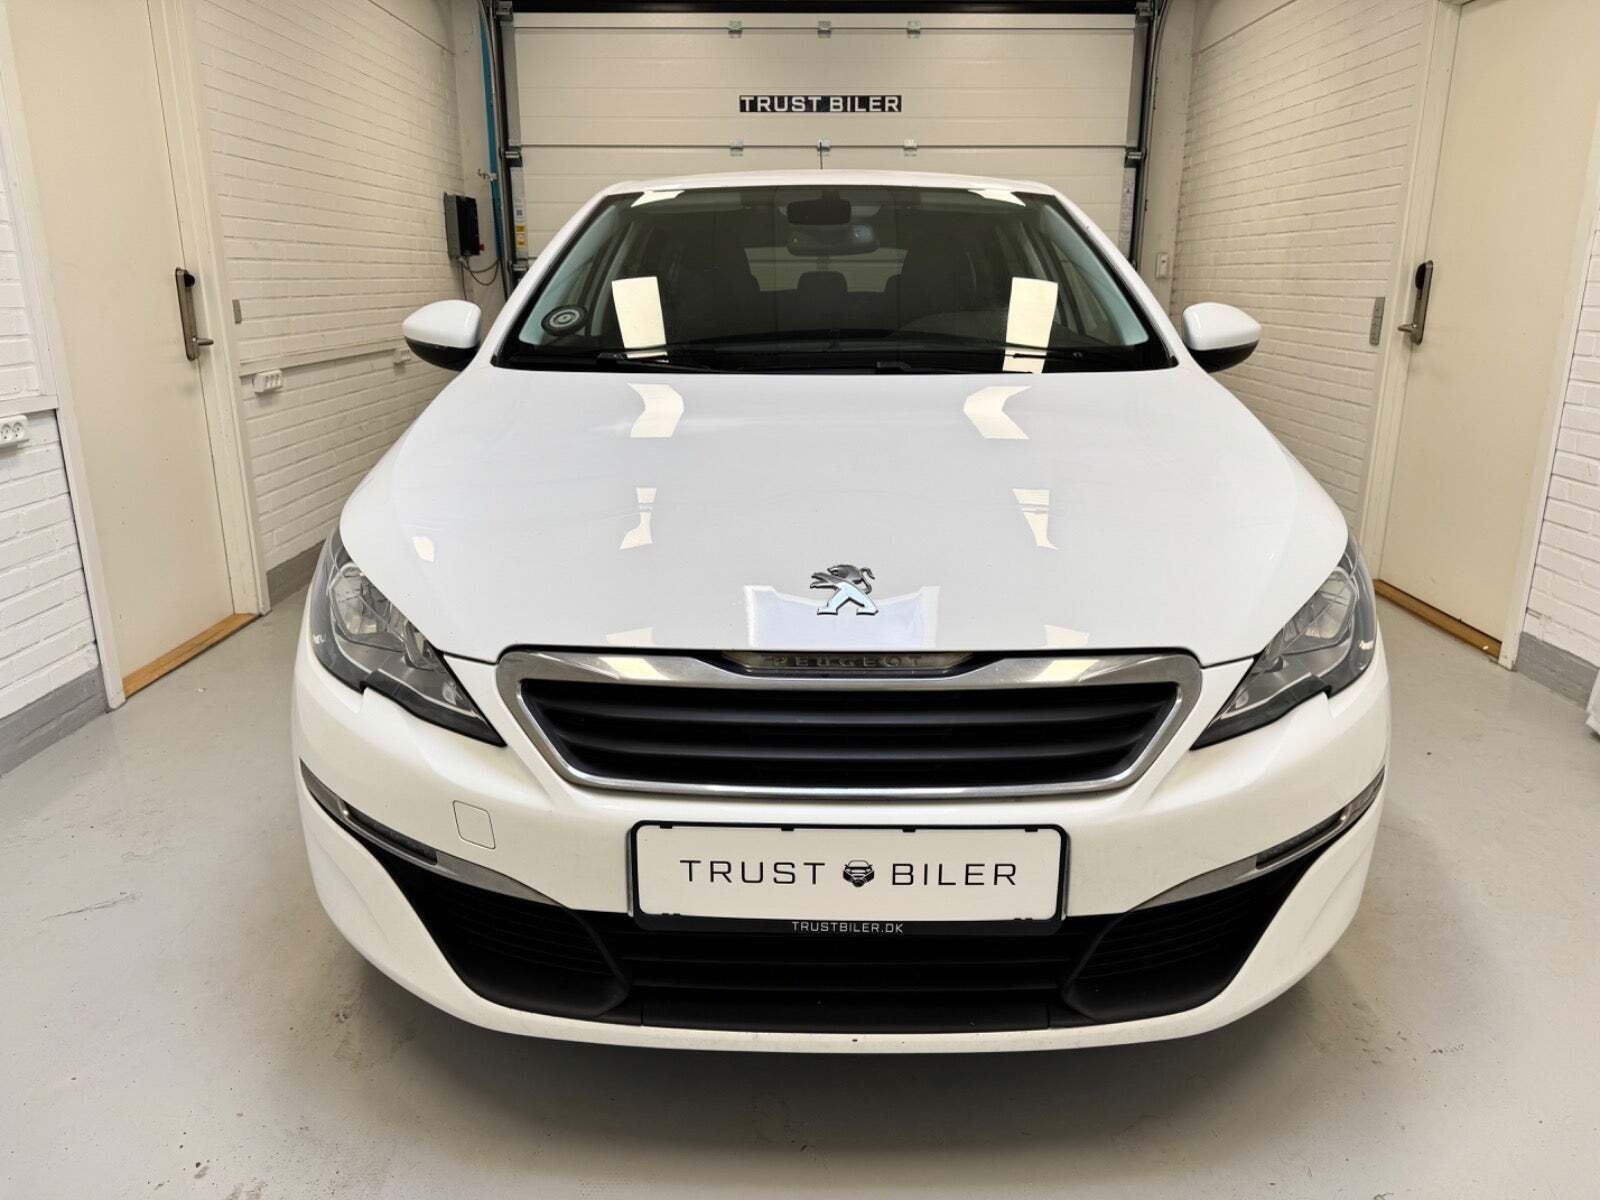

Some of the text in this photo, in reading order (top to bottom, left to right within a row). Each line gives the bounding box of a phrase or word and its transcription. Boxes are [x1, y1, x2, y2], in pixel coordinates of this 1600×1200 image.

[740, 96, 899, 112] TRUST BILER
[769, 655, 922, 668] PEUGEOT
[680, 860, 1016, 886] TRUST BILER
[792, 921, 903, 934] TRUSTBILER.DK
